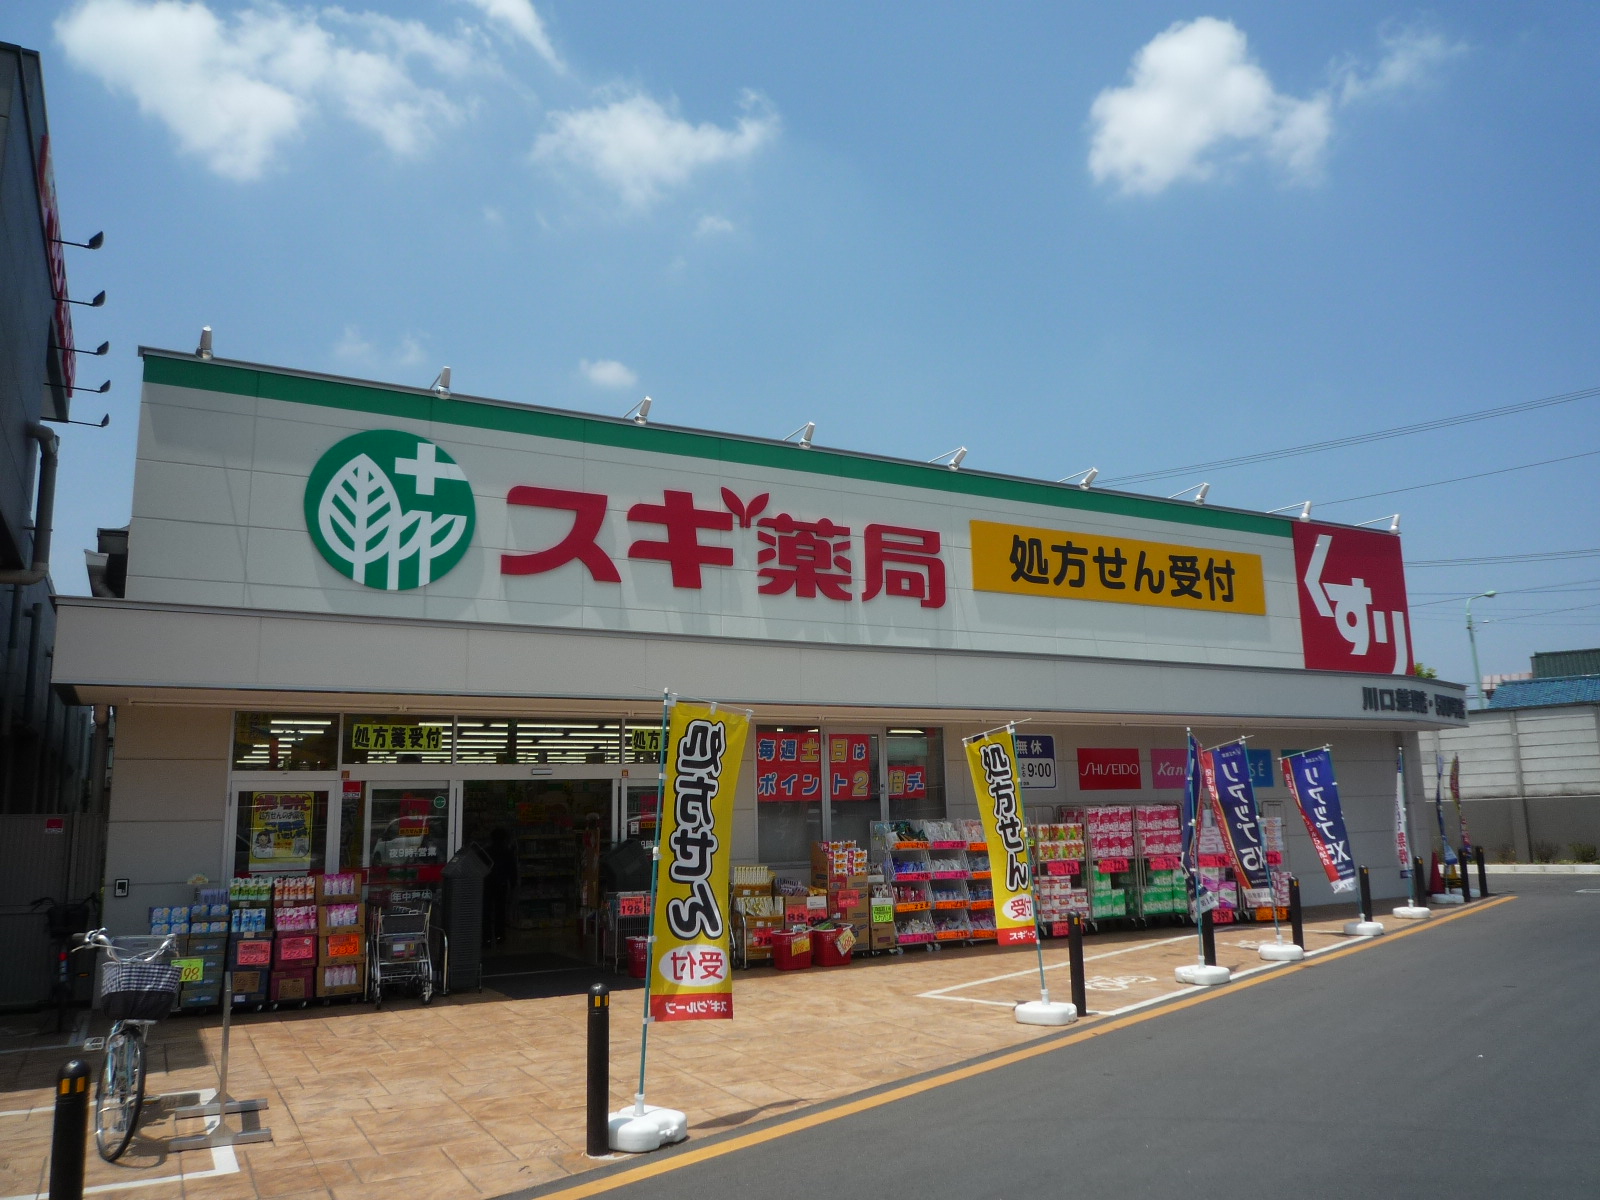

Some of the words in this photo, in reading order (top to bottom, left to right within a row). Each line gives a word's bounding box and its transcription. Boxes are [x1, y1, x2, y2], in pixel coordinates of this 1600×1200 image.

[501, 486, 946, 608] スギ薬局
[1009, 534, 1235, 602] 処方せん受付
[1304, 534, 1407, 674] くすり
[354, 726, 441, 748] 処方箋受付
[757, 738, 866, 763] 毎週土日は
[1027, 763, 1052, 778] 9:00
[1080, 762, 1139, 776] SHISEIDO
[757, 770, 924, 797] ポイント2倍デー
[980, 743, 1029, 892] 処方せん
